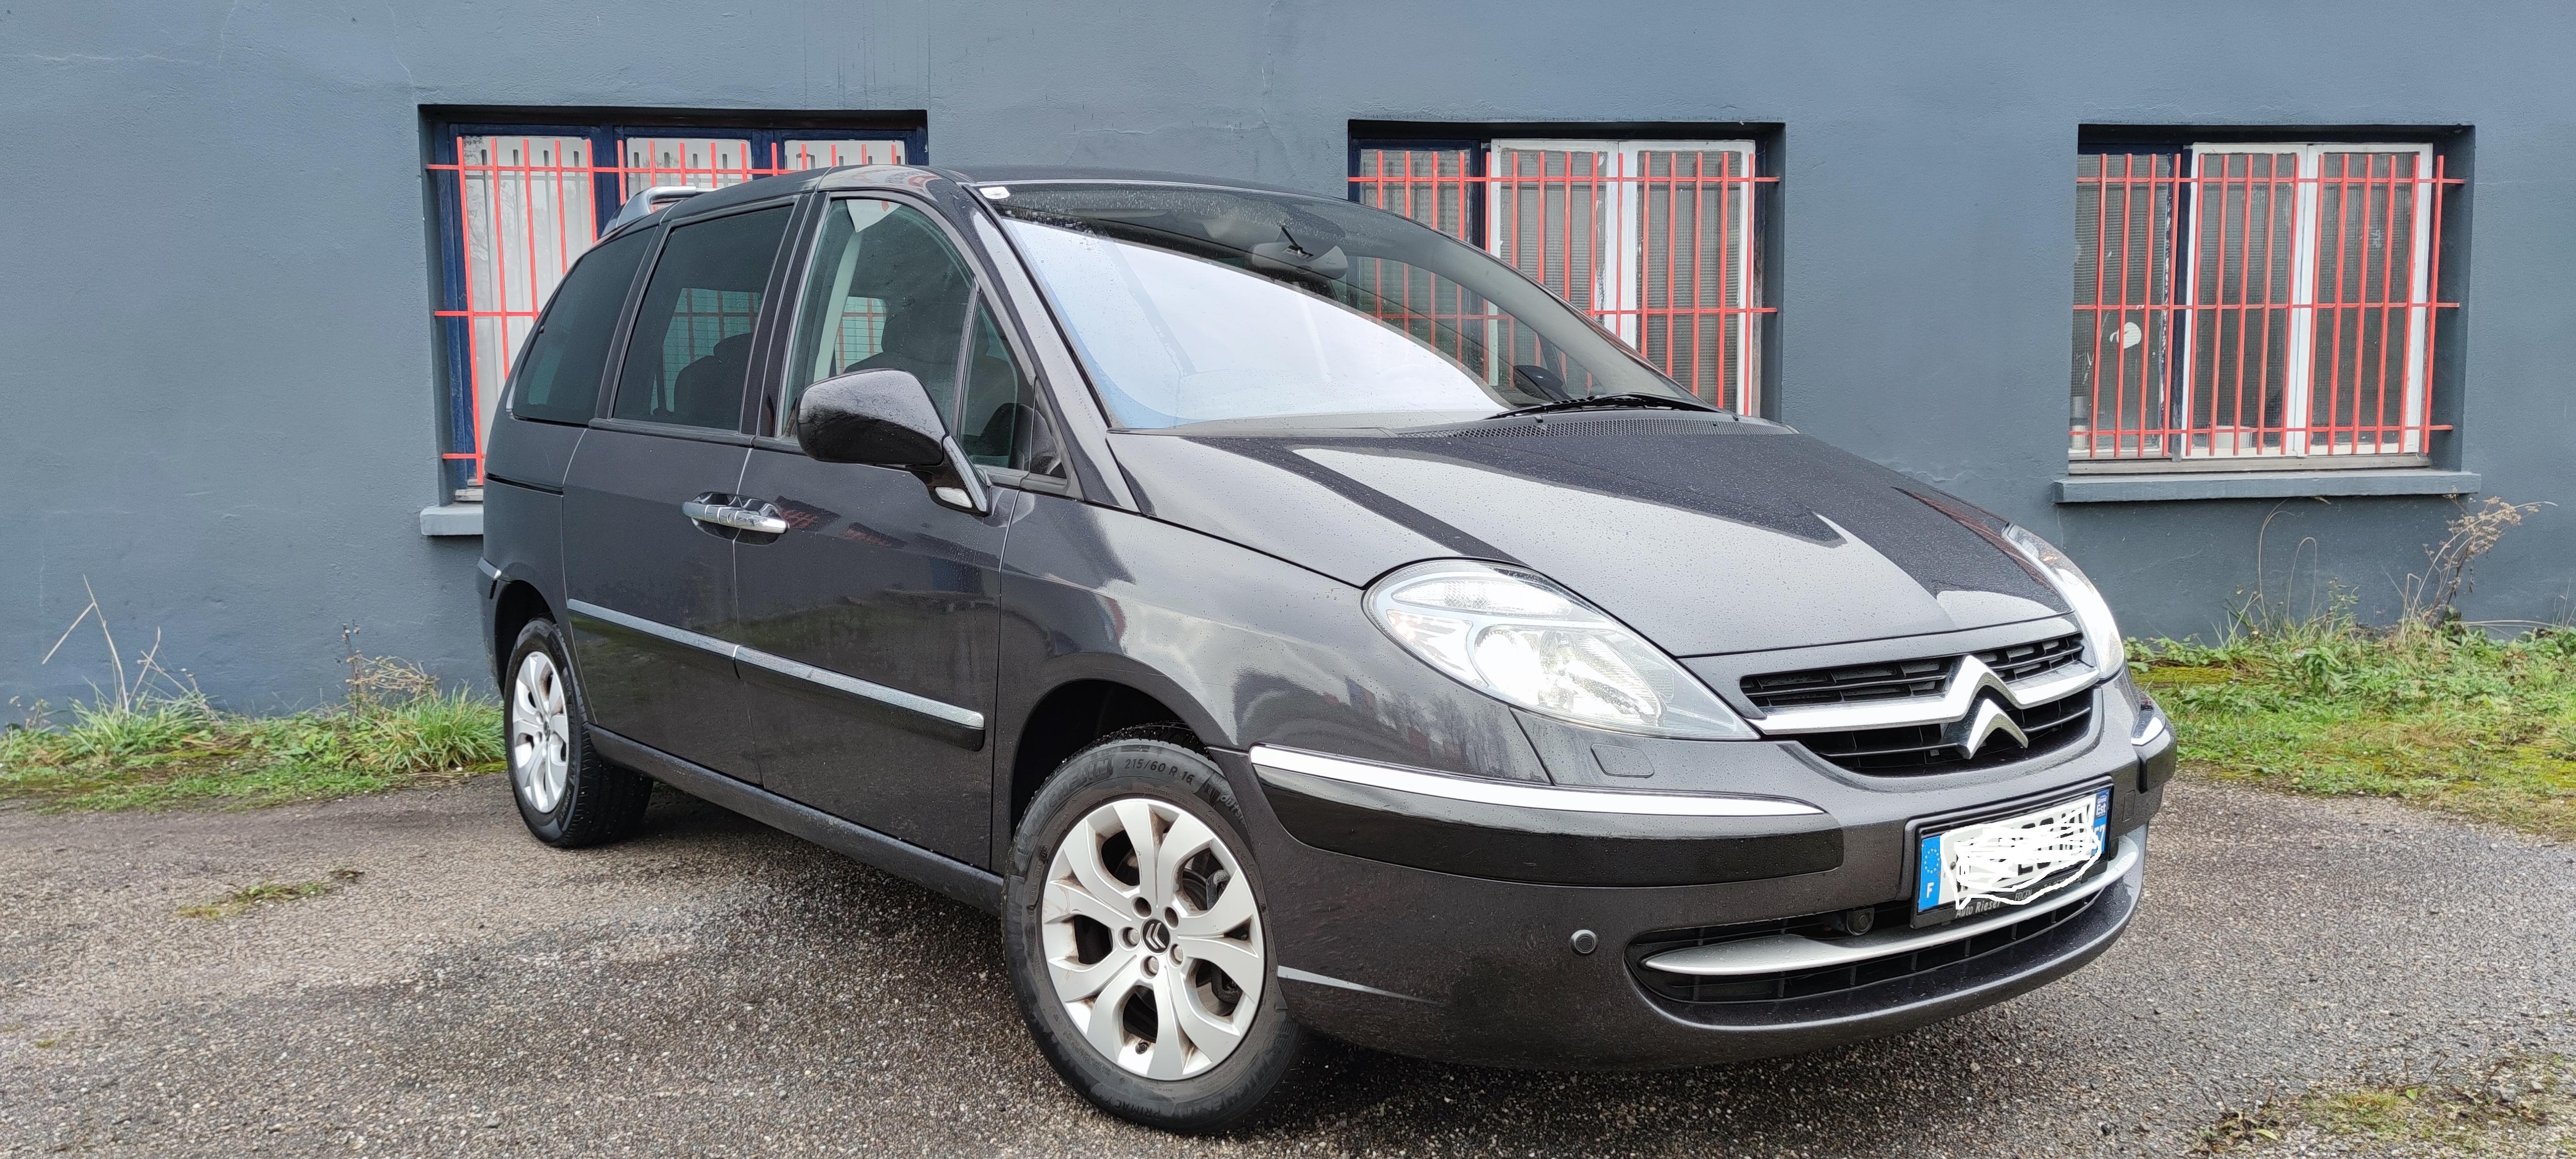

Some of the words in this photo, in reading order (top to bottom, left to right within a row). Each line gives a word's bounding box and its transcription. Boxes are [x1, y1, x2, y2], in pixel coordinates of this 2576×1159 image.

[1124, 759, 1166, 773] 215/60
[1169, 766, 1178, 777] R
[1182, 771, 1195, 784] 16
[2096, 803, 2106, 816] Est
[1926, 881, 1935, 899] F
[1955, 905, 1974, 918] Auto
[1975, 900, 2001, 913] Rieser
